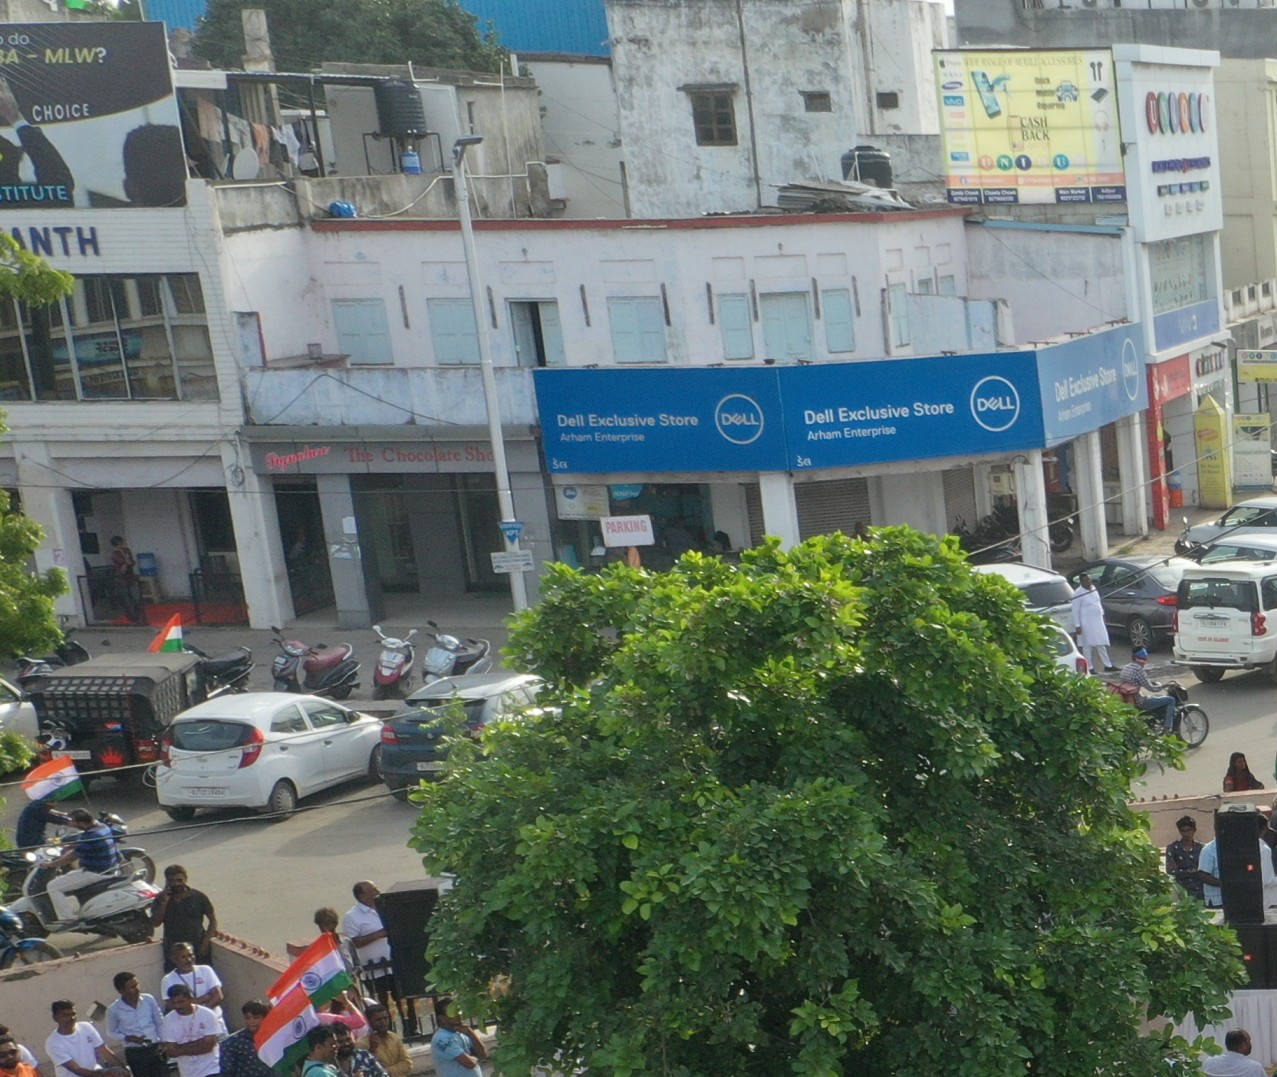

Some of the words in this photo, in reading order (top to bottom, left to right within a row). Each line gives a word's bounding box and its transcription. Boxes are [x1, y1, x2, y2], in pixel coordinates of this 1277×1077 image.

[8, 32, 30, 46] do
[45, 47, 107, 65] MLW?
[32, 103, 91, 122] CHOICE
[1021, 117, 1048, 129] CASH
[1022, 129, 1050, 141] BACK
[977, 396, 1016, 412] DELL
[557, 414, 585, 427] Dell
[588, 414, 655, 427] Exclusive
[659, 413, 699, 427] Store
[721, 413, 760, 426] DELL
[804, 408, 834, 425] Dell
[838, 404, 910, 422] Exclusive
[913, 402, 955, 417] Store
[560, 432, 592, 442] Arham
[594, 432, 645, 444] Enterprise
[807, 430, 841, 441] Arham
[844, 426, 896, 439] Enterprise
[344, 447, 374, 463] The
[382, 446, 461, 463] Chocolate
[465, 446, 495, 462] Sho
[605, 519, 648, 535] PARKING
